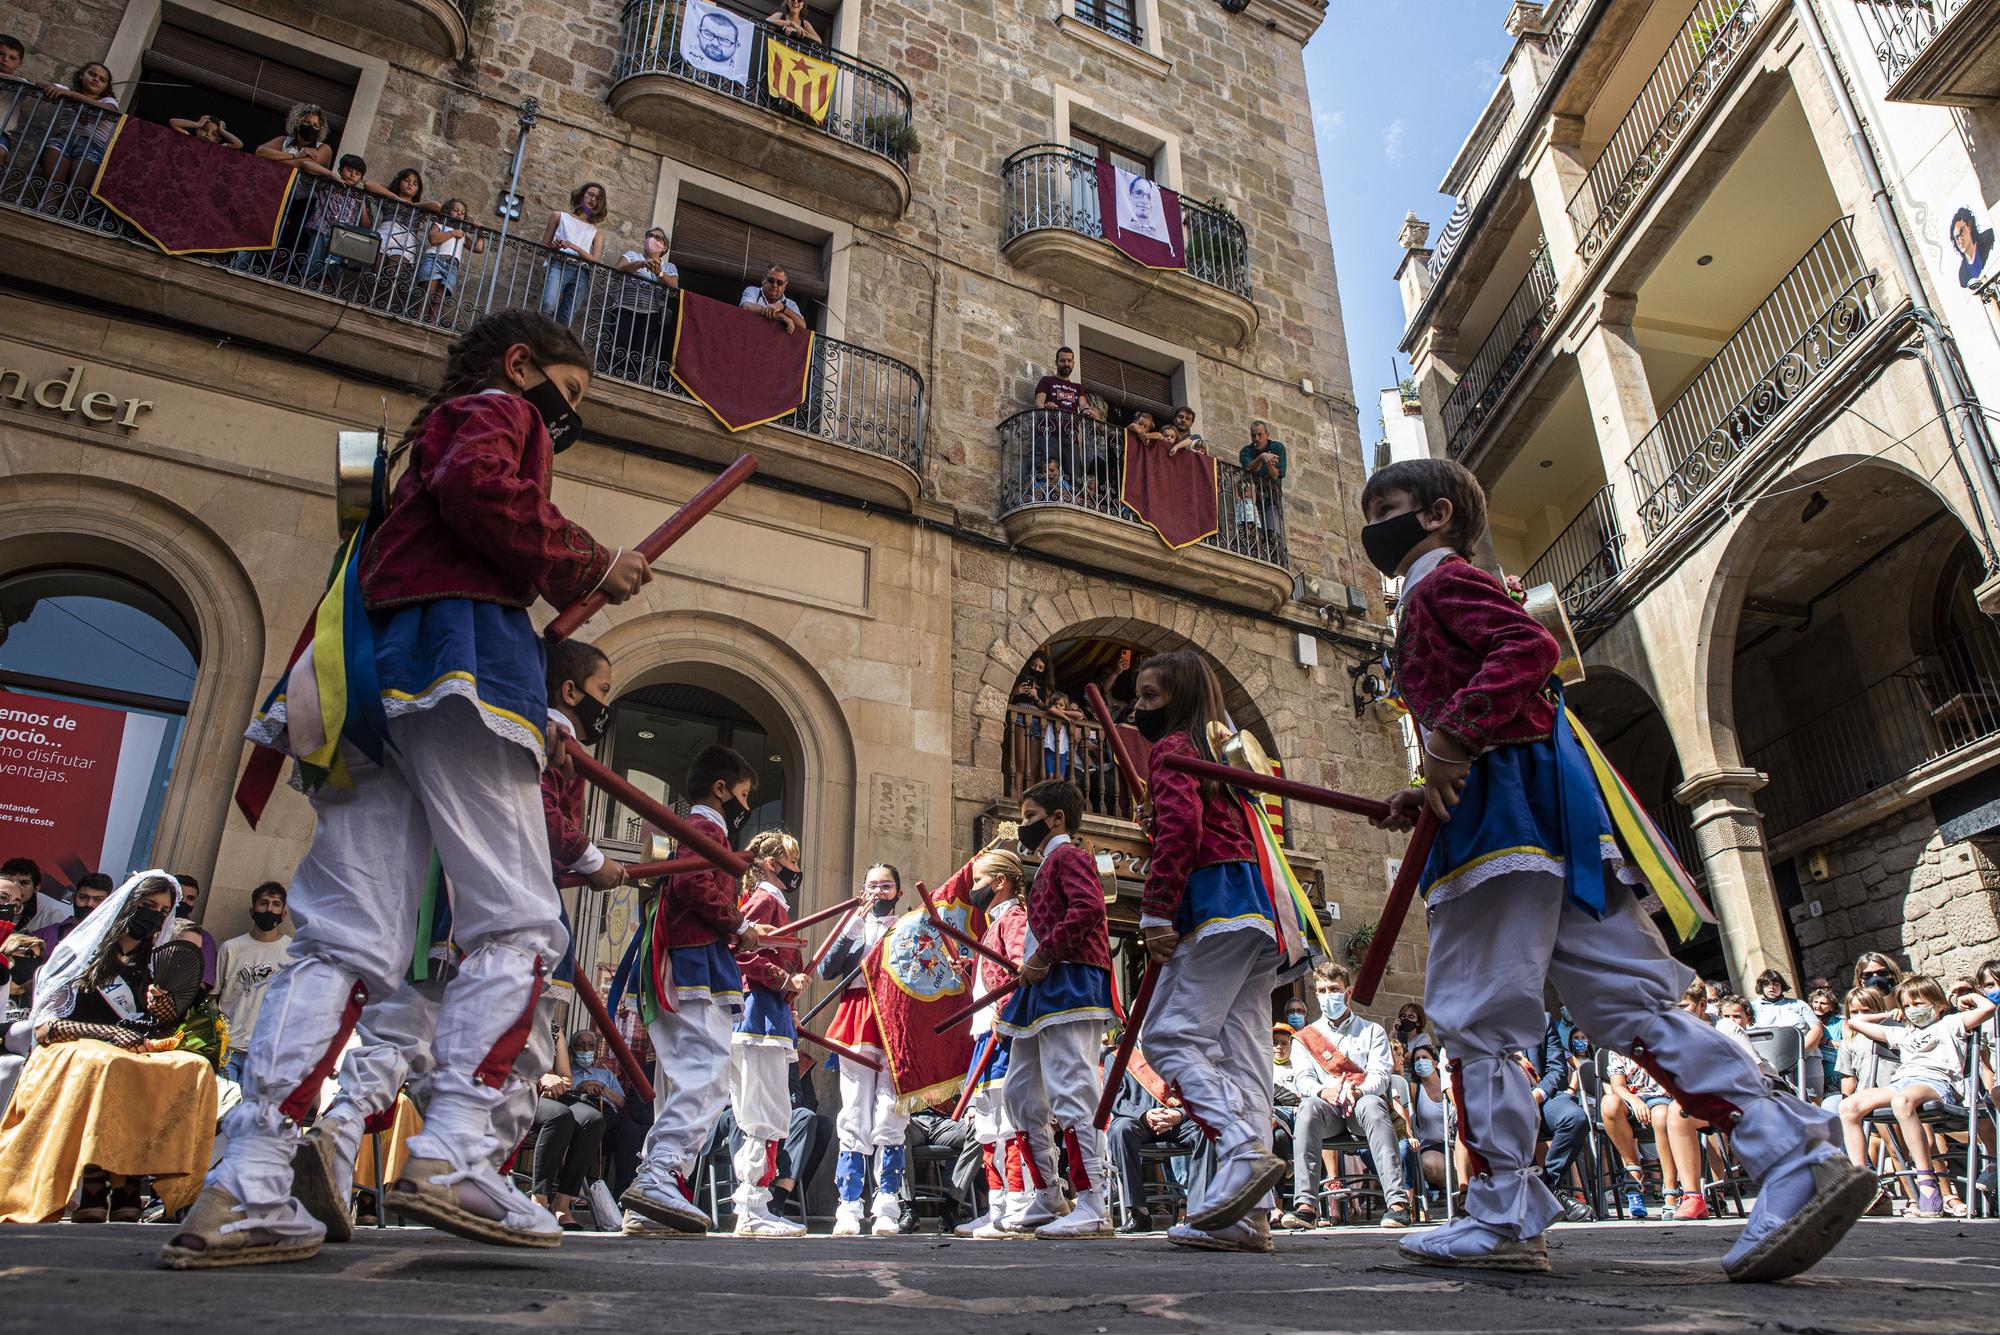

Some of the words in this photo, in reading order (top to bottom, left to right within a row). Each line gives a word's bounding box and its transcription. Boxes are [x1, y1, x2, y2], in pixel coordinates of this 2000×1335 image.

[53, 715, 77, 731] de
[27, 748, 96, 769] disfrutar
[15, 815, 28, 823] sin
[30, 817, 55, 827] coste
[1330, 904, 1336, 916] 7
